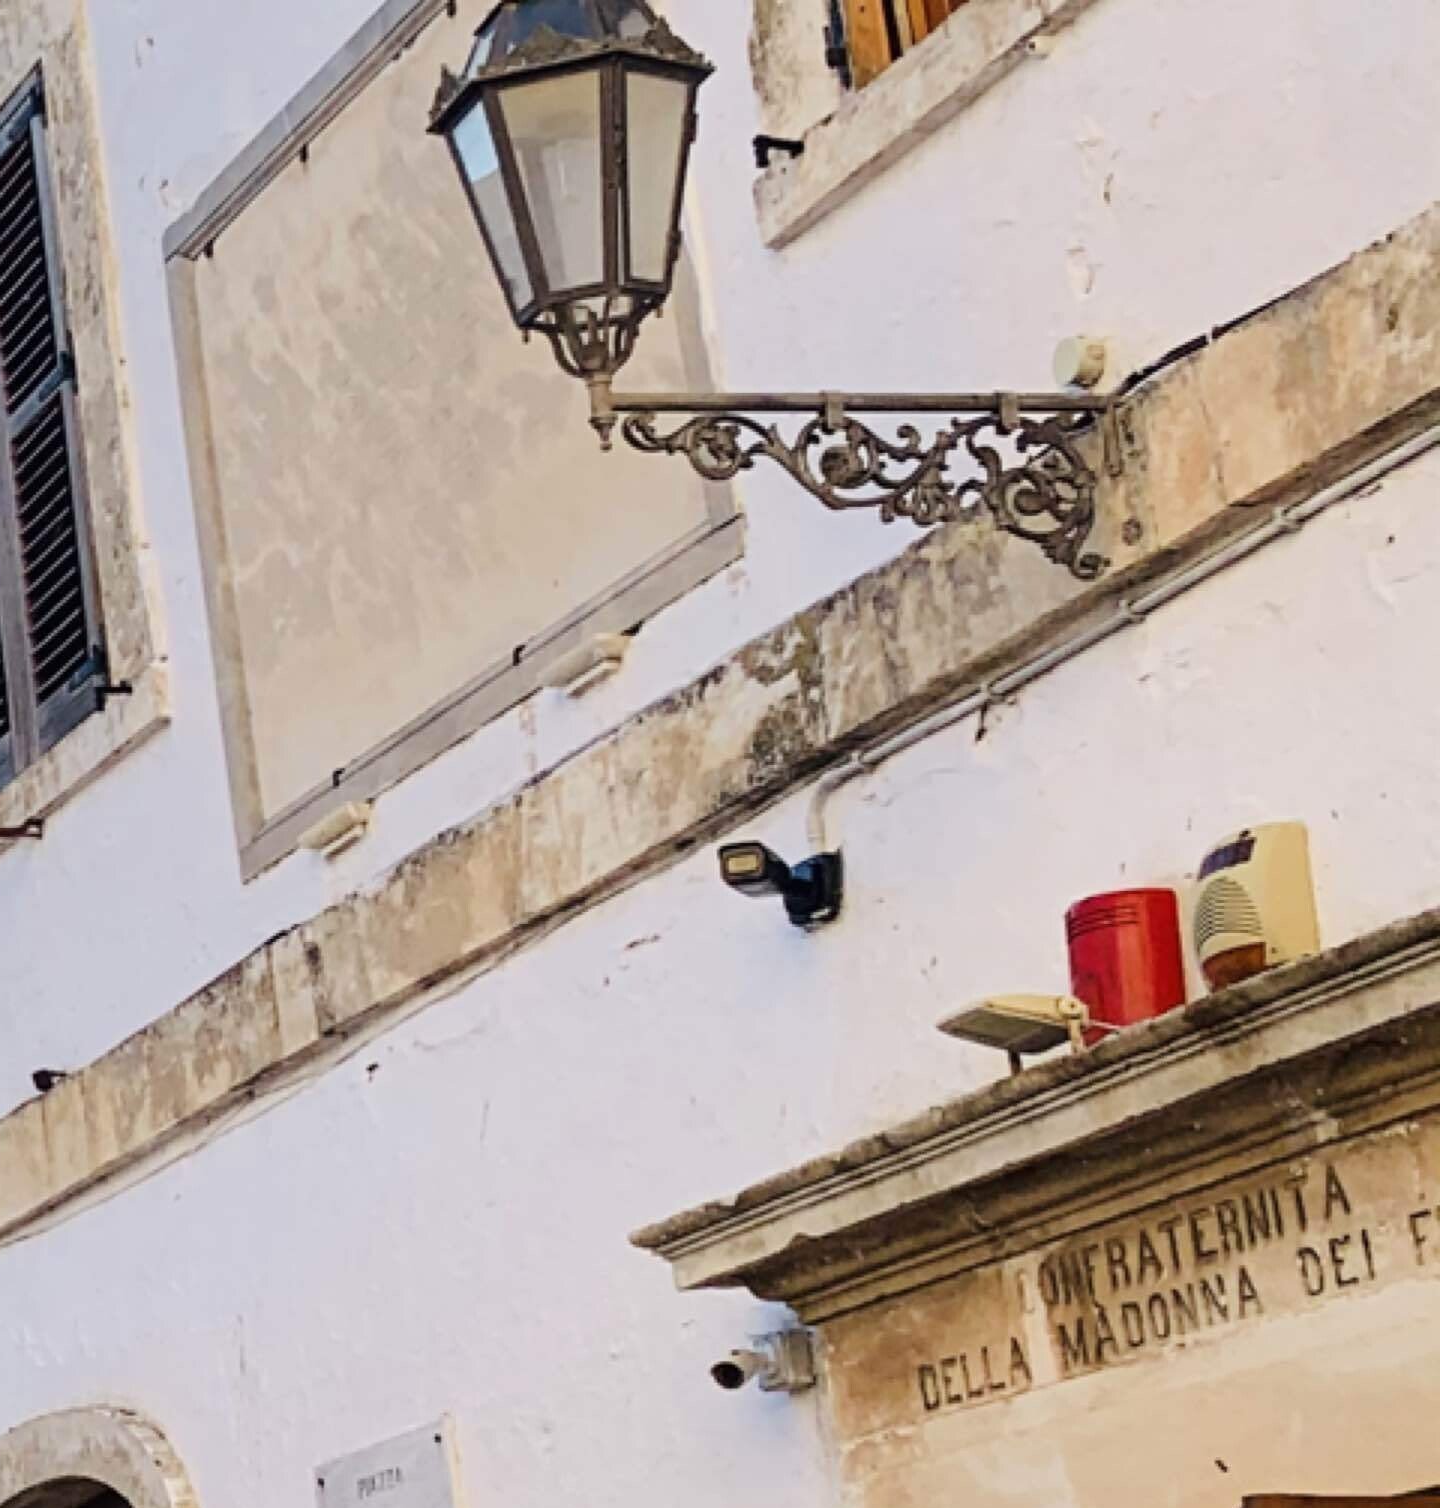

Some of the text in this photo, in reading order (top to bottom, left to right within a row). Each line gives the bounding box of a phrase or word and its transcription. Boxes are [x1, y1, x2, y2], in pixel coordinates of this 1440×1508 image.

[917, 1336, 1033, 1412] DELLA
[1056, 1264, 1264, 1370] MADONNA
[1297, 1228, 1376, 1298] DEI
